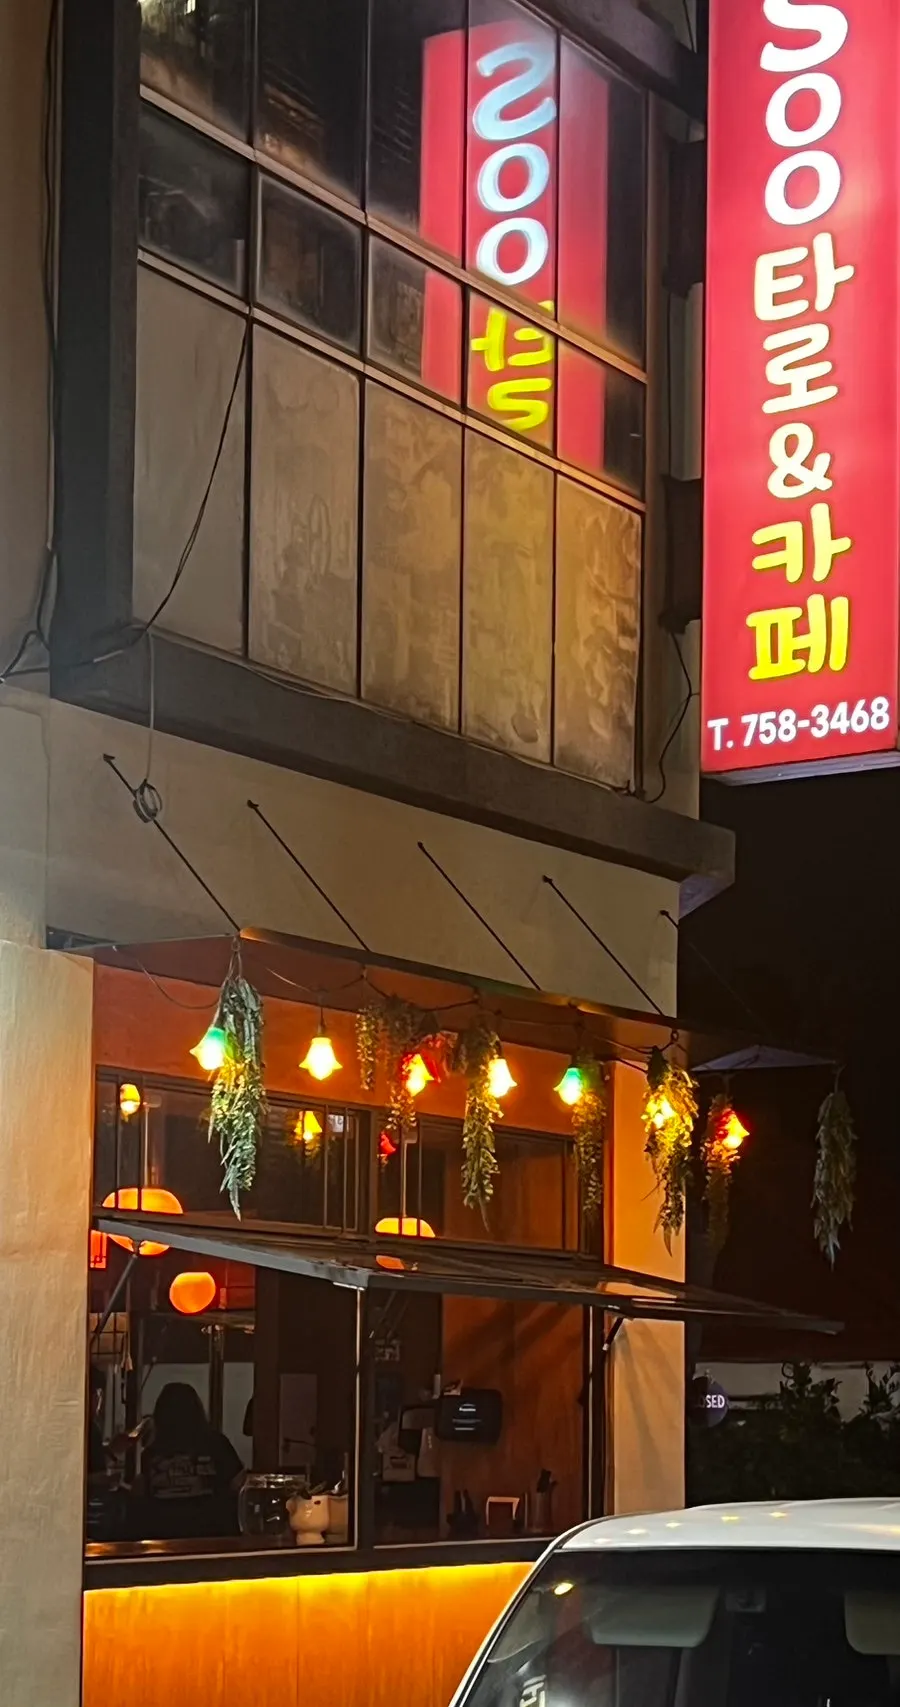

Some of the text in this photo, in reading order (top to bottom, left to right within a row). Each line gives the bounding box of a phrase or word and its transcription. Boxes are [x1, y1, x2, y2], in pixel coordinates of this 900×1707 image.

[759, 0, 849, 226] SOO
[707, 696, 890, 751] T. 758-3468
[704, 1394, 725, 1409] SED
